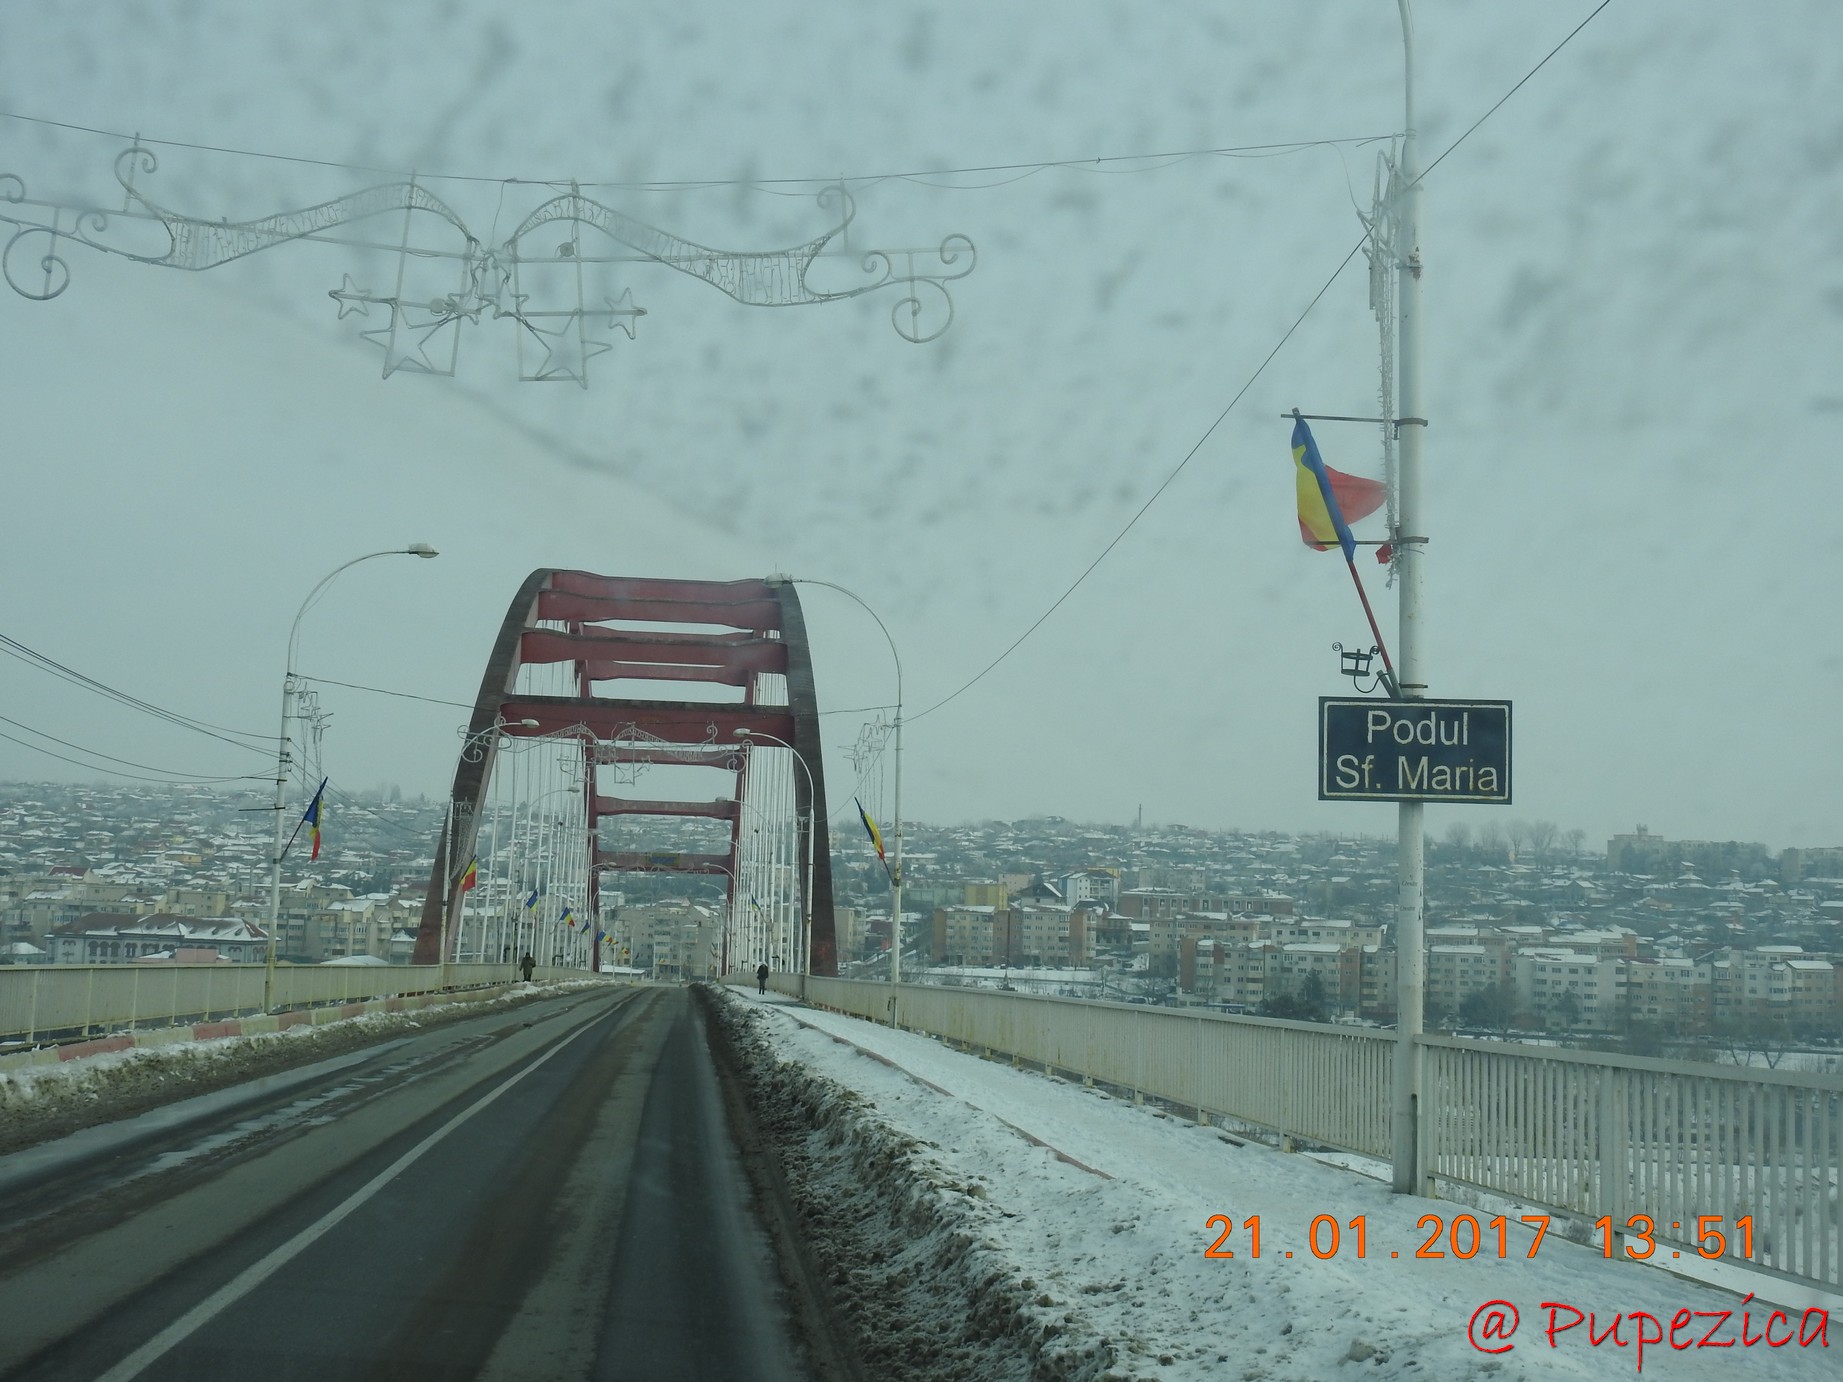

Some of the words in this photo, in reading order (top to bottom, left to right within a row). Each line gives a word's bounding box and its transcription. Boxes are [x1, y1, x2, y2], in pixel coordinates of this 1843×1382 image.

[1367, 710, 1469, 746] Podul
[1335, 754, 1382, 789] Sf.
[1398, 755, 1498, 792] Maria
